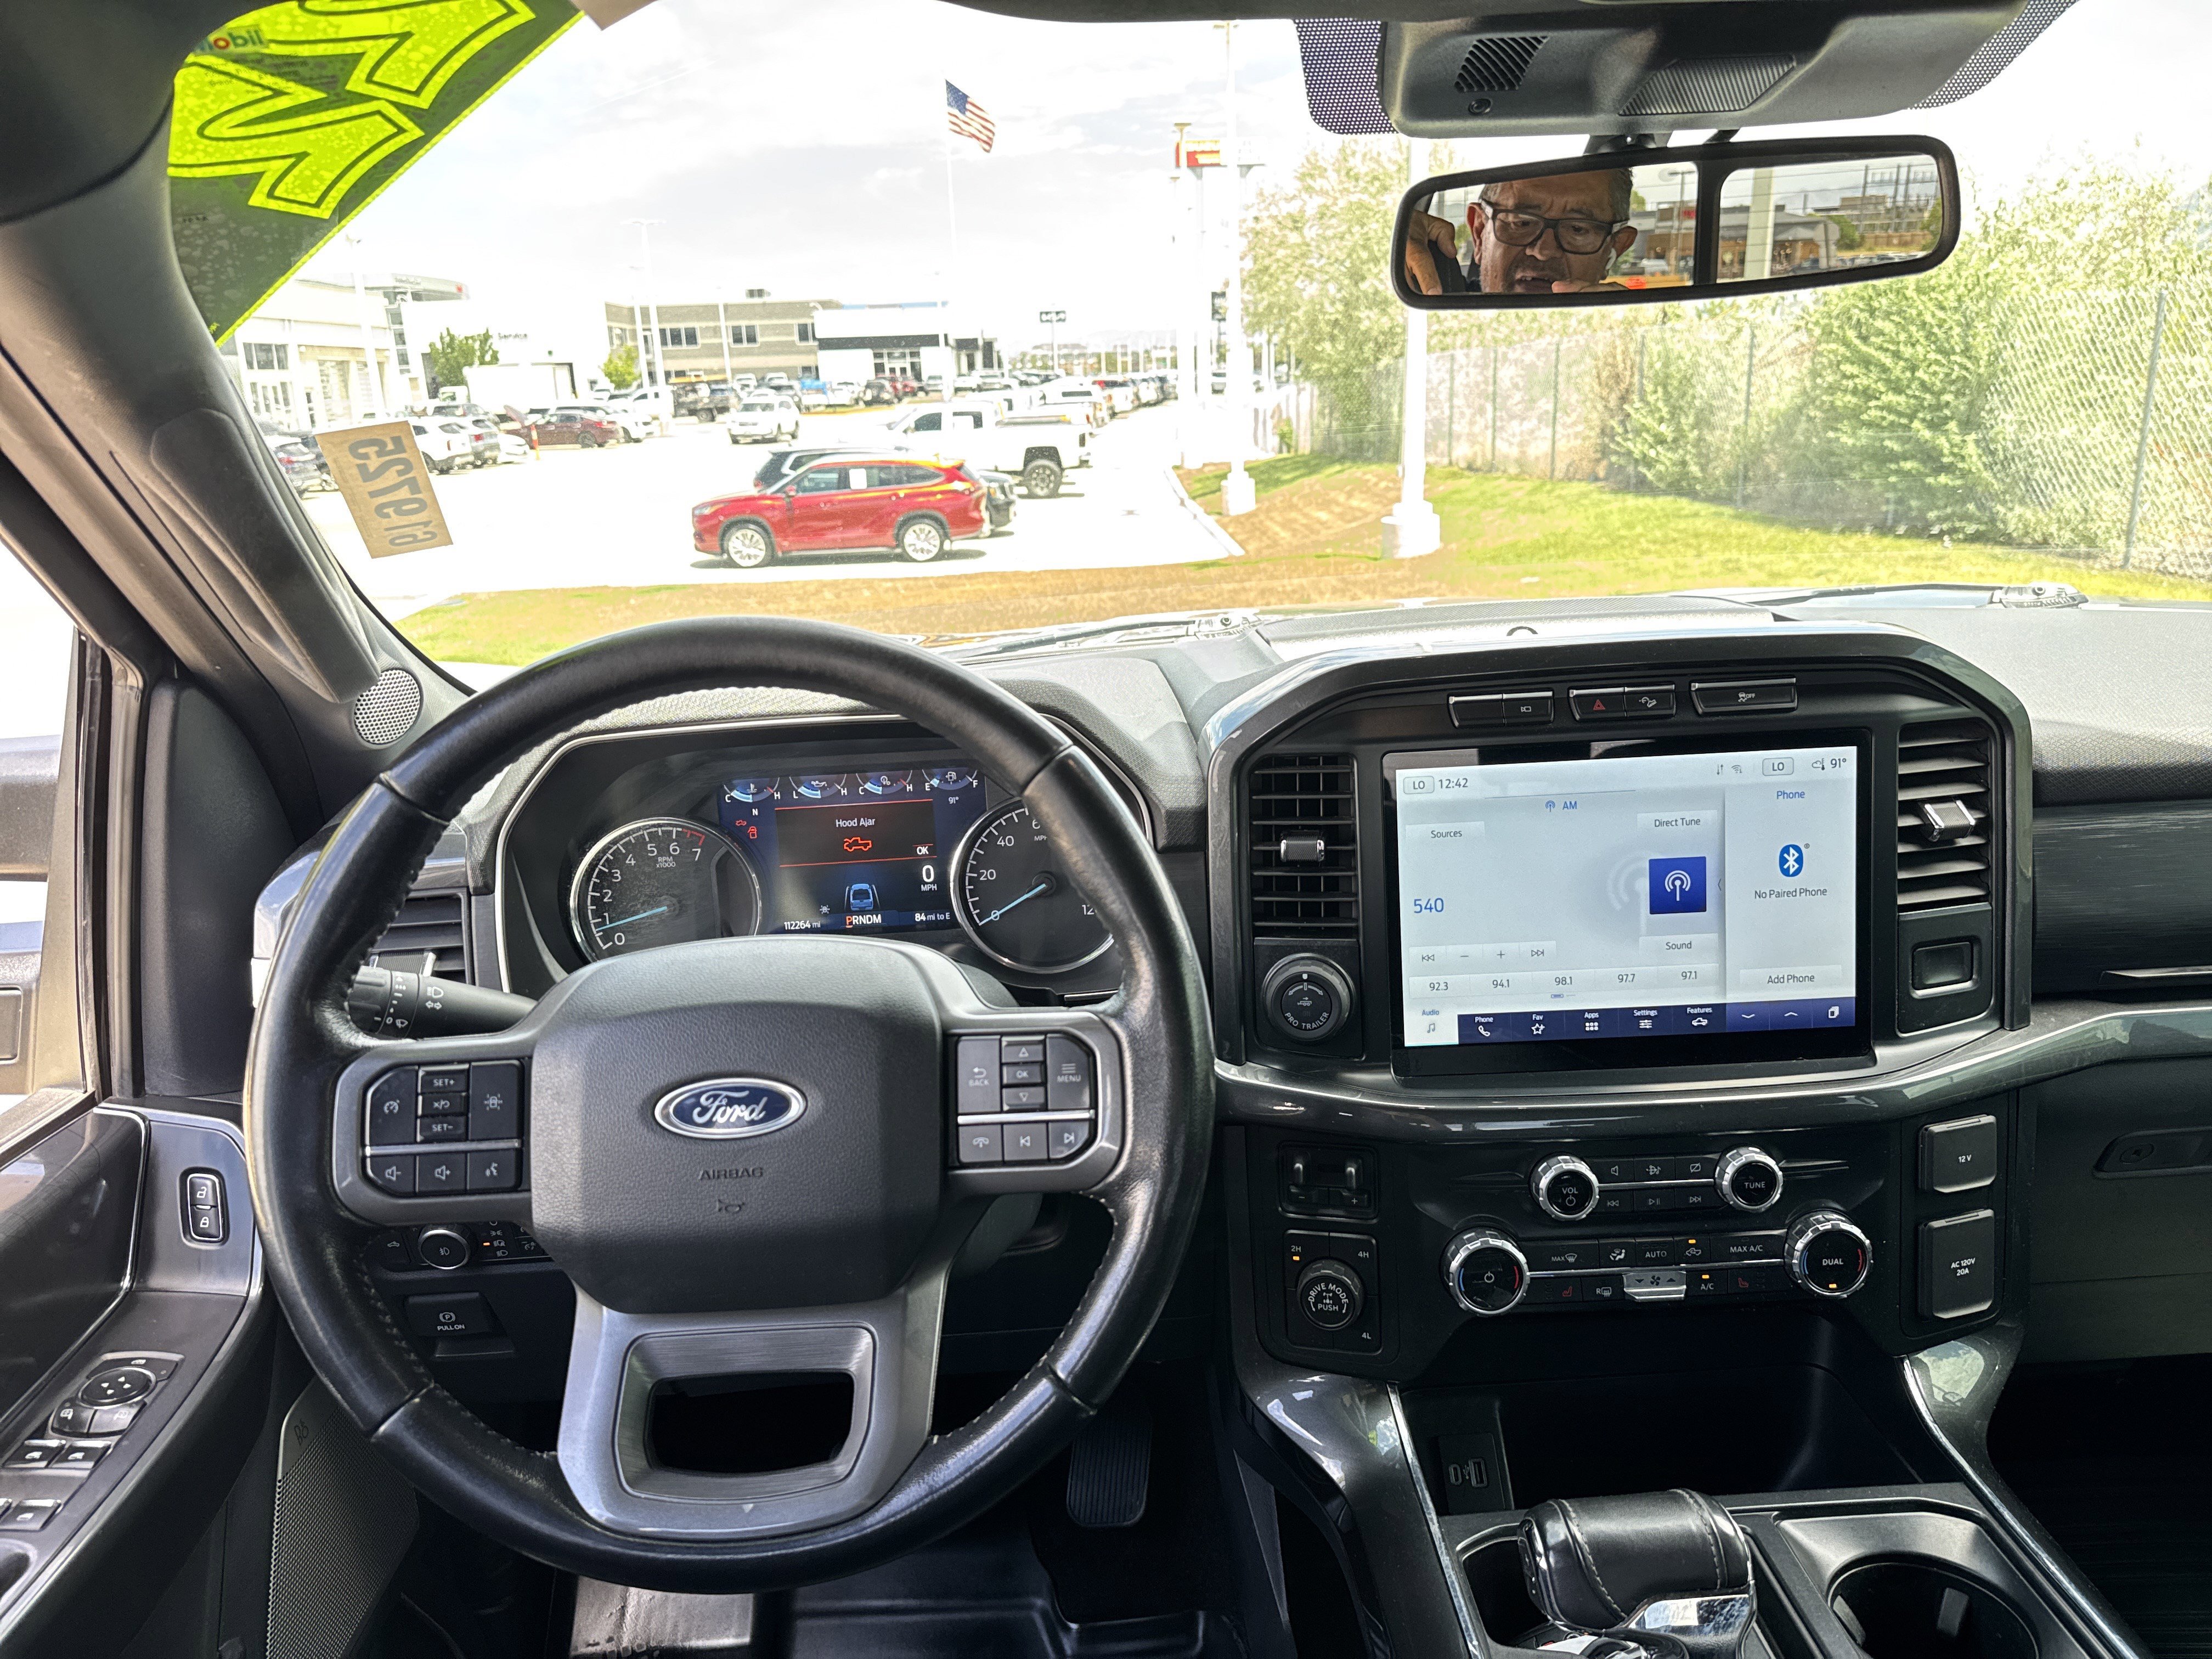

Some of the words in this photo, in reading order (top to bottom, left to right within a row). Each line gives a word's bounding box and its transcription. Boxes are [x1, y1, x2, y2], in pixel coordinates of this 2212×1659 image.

[1772, 762, 1785, 772] LO
[1830, 758, 1847, 769] 91°
[906, 784, 912, 792] H
[1413, 781, 1425, 790] LO
[1438, 778, 1468, 789] 12:42
[1776, 790, 1805, 800] Phone
[1562, 801, 1577, 810] AM
[836, 819, 857, 827] Hood
[860, 817, 876, 826] Ajar
[1654, 819, 1678, 828] Direct
[1680, 817, 1701, 826] Tune
[1431, 830, 1462, 838] Sources
[997, 836, 1014, 847] 40
[647, 844, 657, 856] 5
[669, 842, 680, 855] 6
[916, 846, 928, 854] OK
[625, 854, 636, 866] 4
[692, 848, 702, 861] 7
[611, 870, 621, 882] 3
[922, 865, 934, 882] 0
[980, 870, 996, 881] 20
[603, 889, 613, 902] 2
[1754, 890, 1767, 899] No
[1769, 888, 1797, 898] Paired
[1798, 887, 1827, 897] Phone
[1082, 904, 1095, 915] 12
[1413, 898, 1444, 913] 540
[603, 913, 610, 924] 1
[846, 914, 881, 926] PRNDM
[915, 913, 926, 921] 84
[784, 921, 811, 930] 112264
[614, 933, 625, 945] 0
[1666, 941, 1692, 951] Sound
[1429, 982, 1448, 991] 92.3
[1492, 979, 1510, 989] 94.1
[1554, 977, 1572, 986] 98.1
[1617, 974, 1635, 983] 97.7
[1681, 970, 1697, 980] 97.1
[1767, 975, 1785, 984] Add
[1787, 974, 1815, 983] Phone
[1633, 1008, 1657, 1017] Settings
[1284, 1012, 1299, 1026] PRO
[1301, 1012, 1329, 1030] TRAILER
[1016, 1070, 1029, 1079] OK
[1057, 1074, 1081, 1084] MENU
[433, 1078, 455, 1087] SET+
[692, 1090, 769, 1124] Ford
[1958, 1155, 1967, 1163] 12
[699, 1167, 763, 1180] AIRBAG
[1951, 1260, 1960, 1269] AC
[1961, 1257, 1976, 1267] 120V
[1956, 1267, 1970, 1277] 20A
[1308, 1283, 1327, 1302] DRIVE
[1328, 1283, 1348, 1304] MODE
